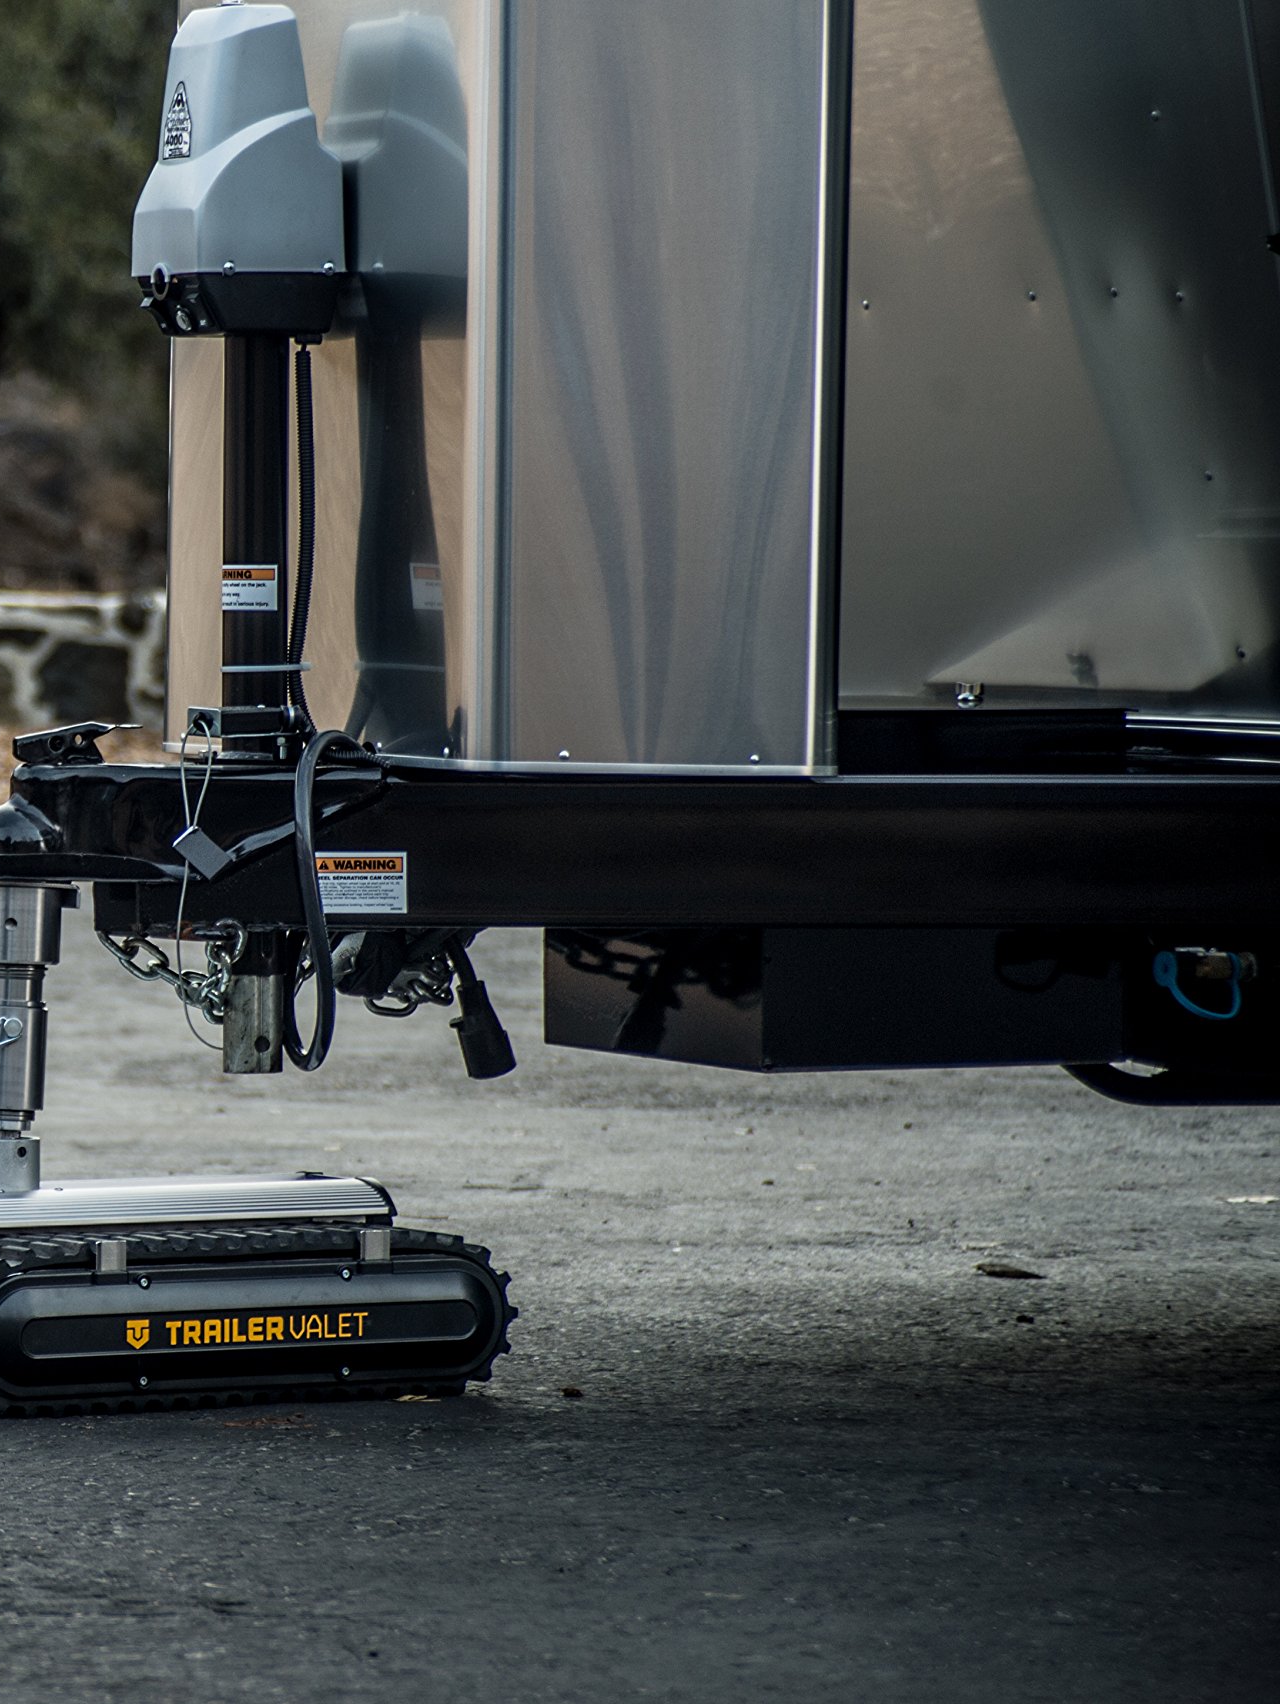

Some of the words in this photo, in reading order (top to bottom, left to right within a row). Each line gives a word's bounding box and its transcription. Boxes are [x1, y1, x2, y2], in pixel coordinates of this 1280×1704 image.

[166, 133, 183, 147] 4000
[333, 859, 397, 870] WARNING
[166, 1316, 285, 1346] TRAILER
[289, 1312, 369, 1340] VALET
